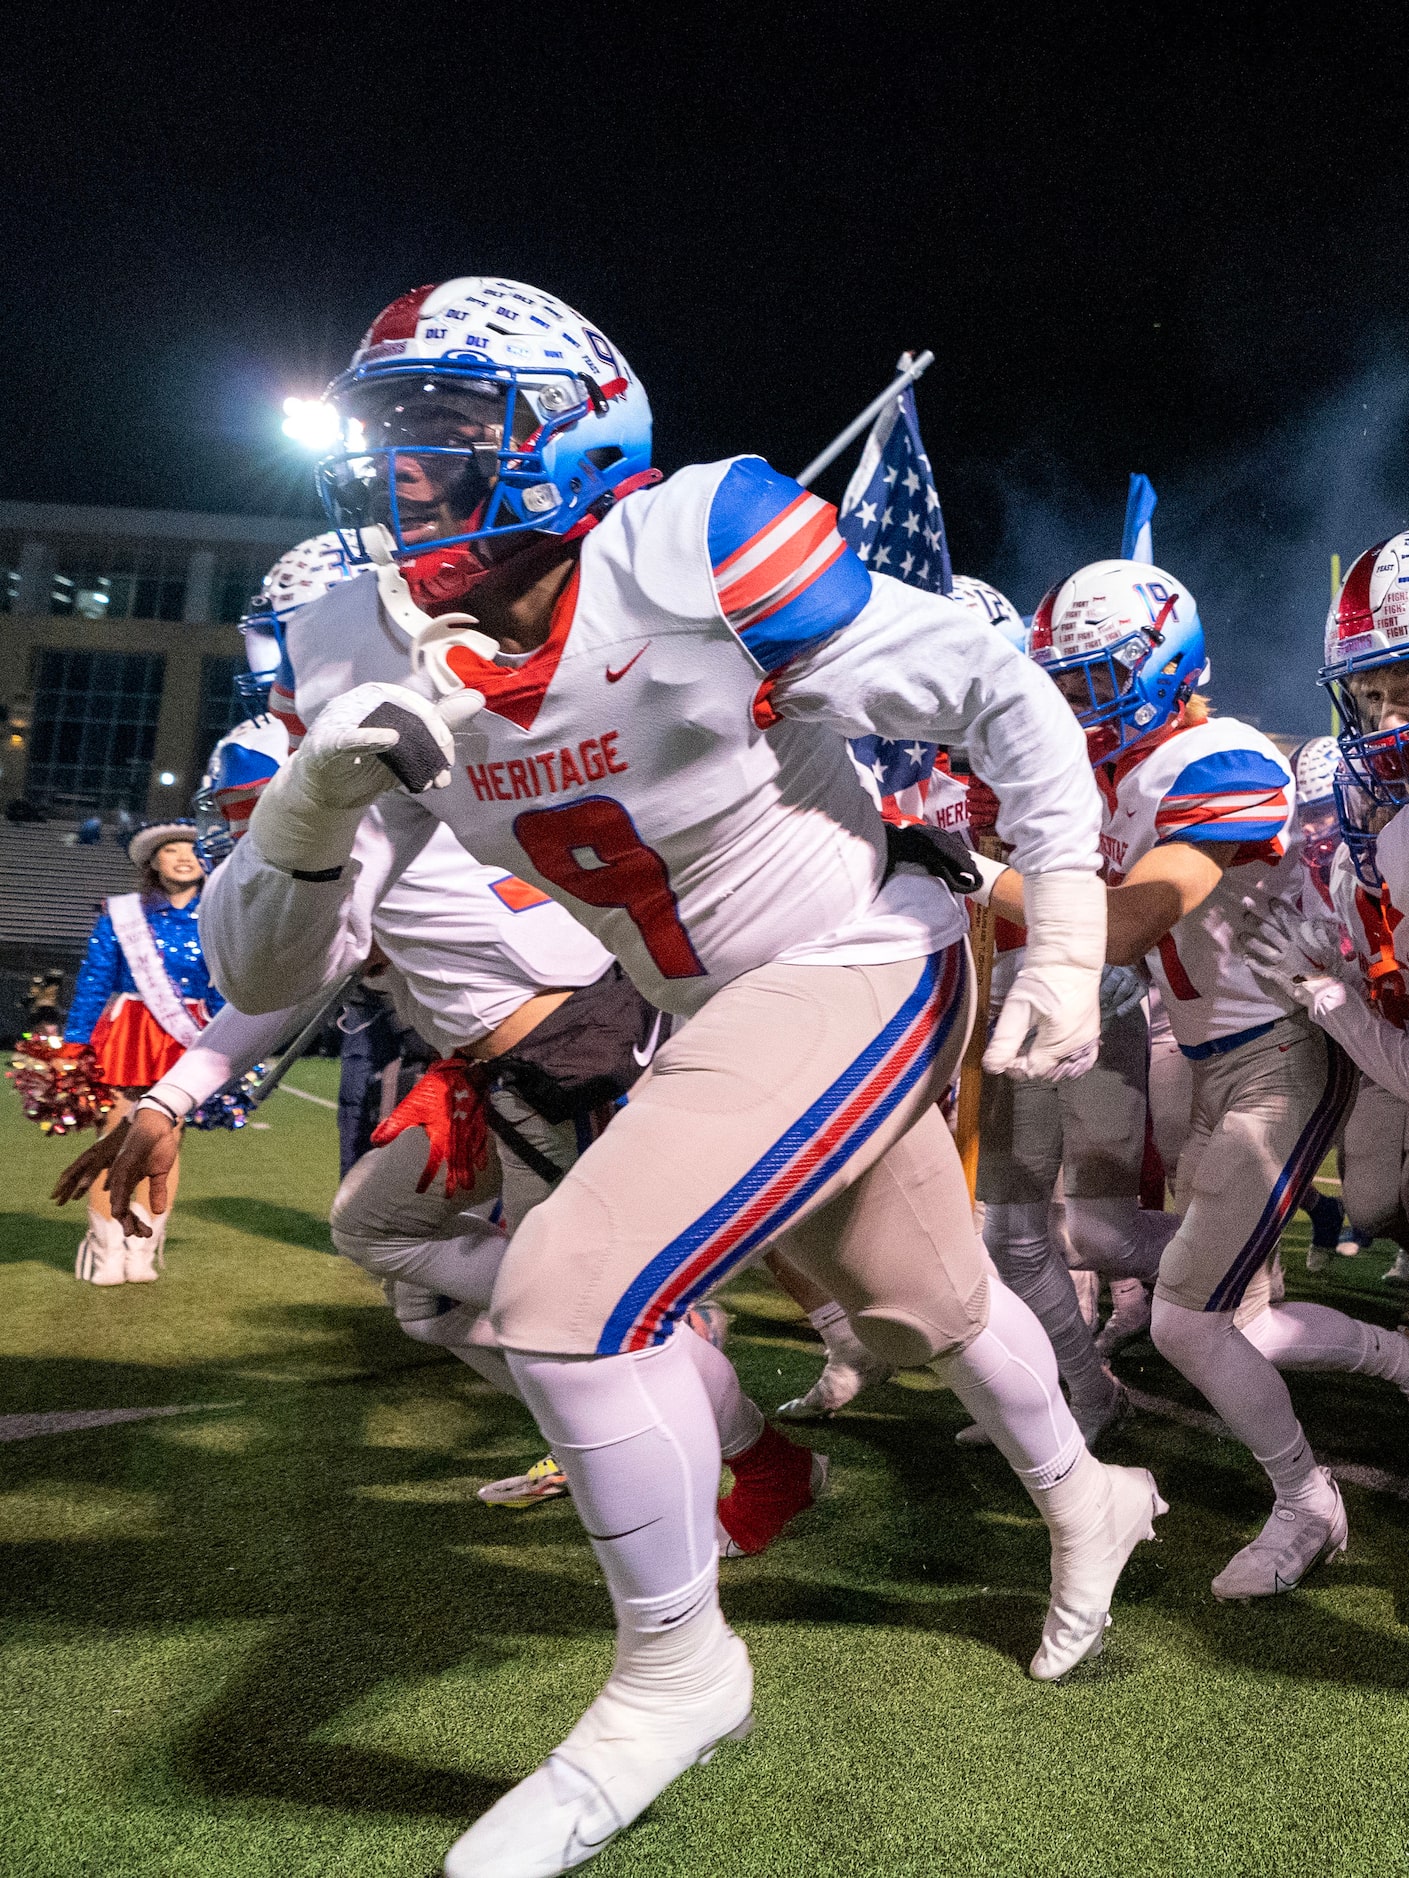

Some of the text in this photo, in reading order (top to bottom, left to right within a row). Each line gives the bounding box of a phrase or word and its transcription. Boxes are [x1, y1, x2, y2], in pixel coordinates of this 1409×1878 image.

[446, 308, 470, 320] DLT
[496, 306, 520, 321] DLT
[426, 328, 448, 339] DLT
[465, 334, 490, 349] DLT
[1376, 564, 1395, 573] FEAST
[1377, 616, 1398, 630] FIGHT
[1386, 625, 1409, 639] FIGHT
[465, 730, 629, 802] HERITAGE
[512, 794, 709, 980] 9
